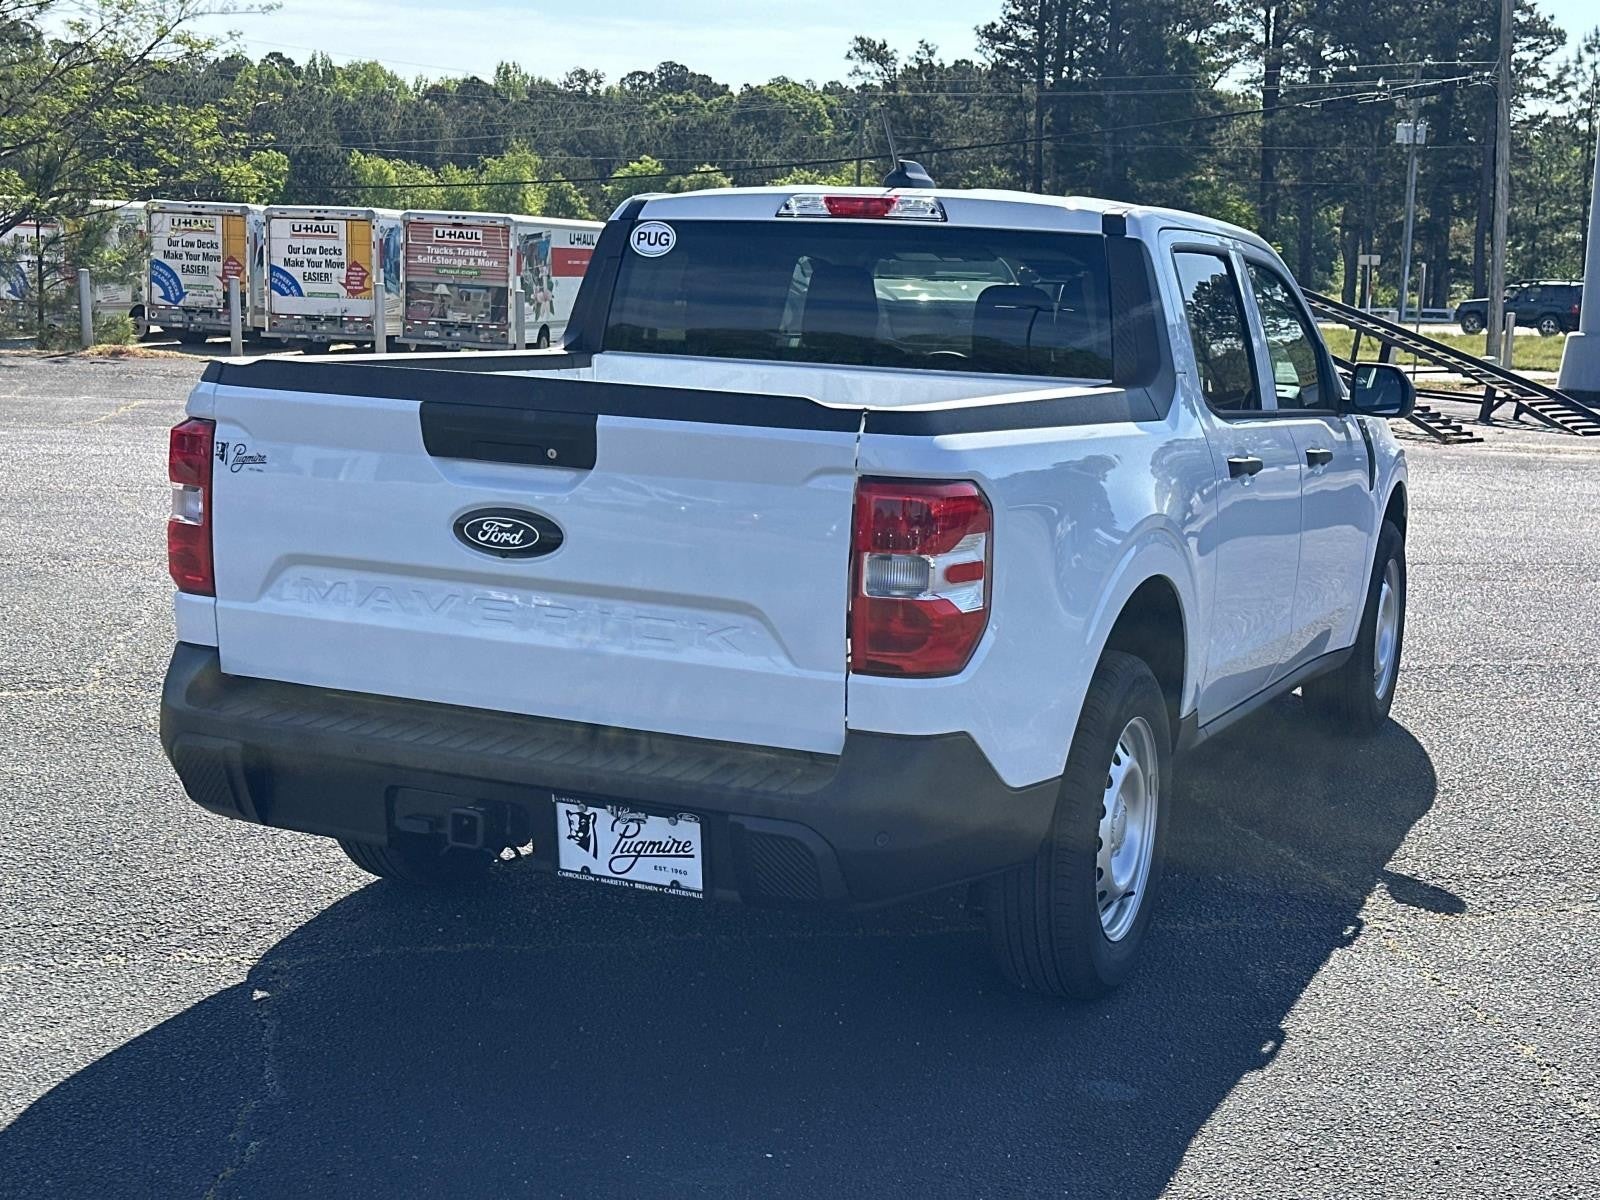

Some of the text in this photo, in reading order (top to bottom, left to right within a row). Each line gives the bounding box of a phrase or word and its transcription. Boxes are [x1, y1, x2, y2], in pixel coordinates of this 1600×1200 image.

[291, 224, 337, 234] U-HAUL
[435, 230, 481, 241] U-HAUL
[167, 237, 219, 250] Our Low Decks
[570, 232, 595, 245] U-HAUL
[637, 232, 670, 246] PUG
[164, 250, 221, 263] Make Your Move
[288, 245, 342, 256] Our Low Decks
[427, 246, 489, 258] Trucks, Trailers,
[284, 258, 345, 269] Make Your Move
[417, 256, 467, 267] Self-Storage
[469, 257, 476, 266] &
[181, 264, 209, 275] EASIER!
[272, 271, 292, 286] LOWEST
[303, 271, 333, 282] EASIER!
[230, 443, 267, 473] Pugmire
[478, 520, 524, 546] Ford
[300, 576, 744, 653] MAVERICK
[608, 818, 695, 875] Pugmire
[654, 865, 688, 876] EST. 1960
[557, 871, 703, 899] CARROLLTON MARIETTA BREMEN CARTERSVILLE
